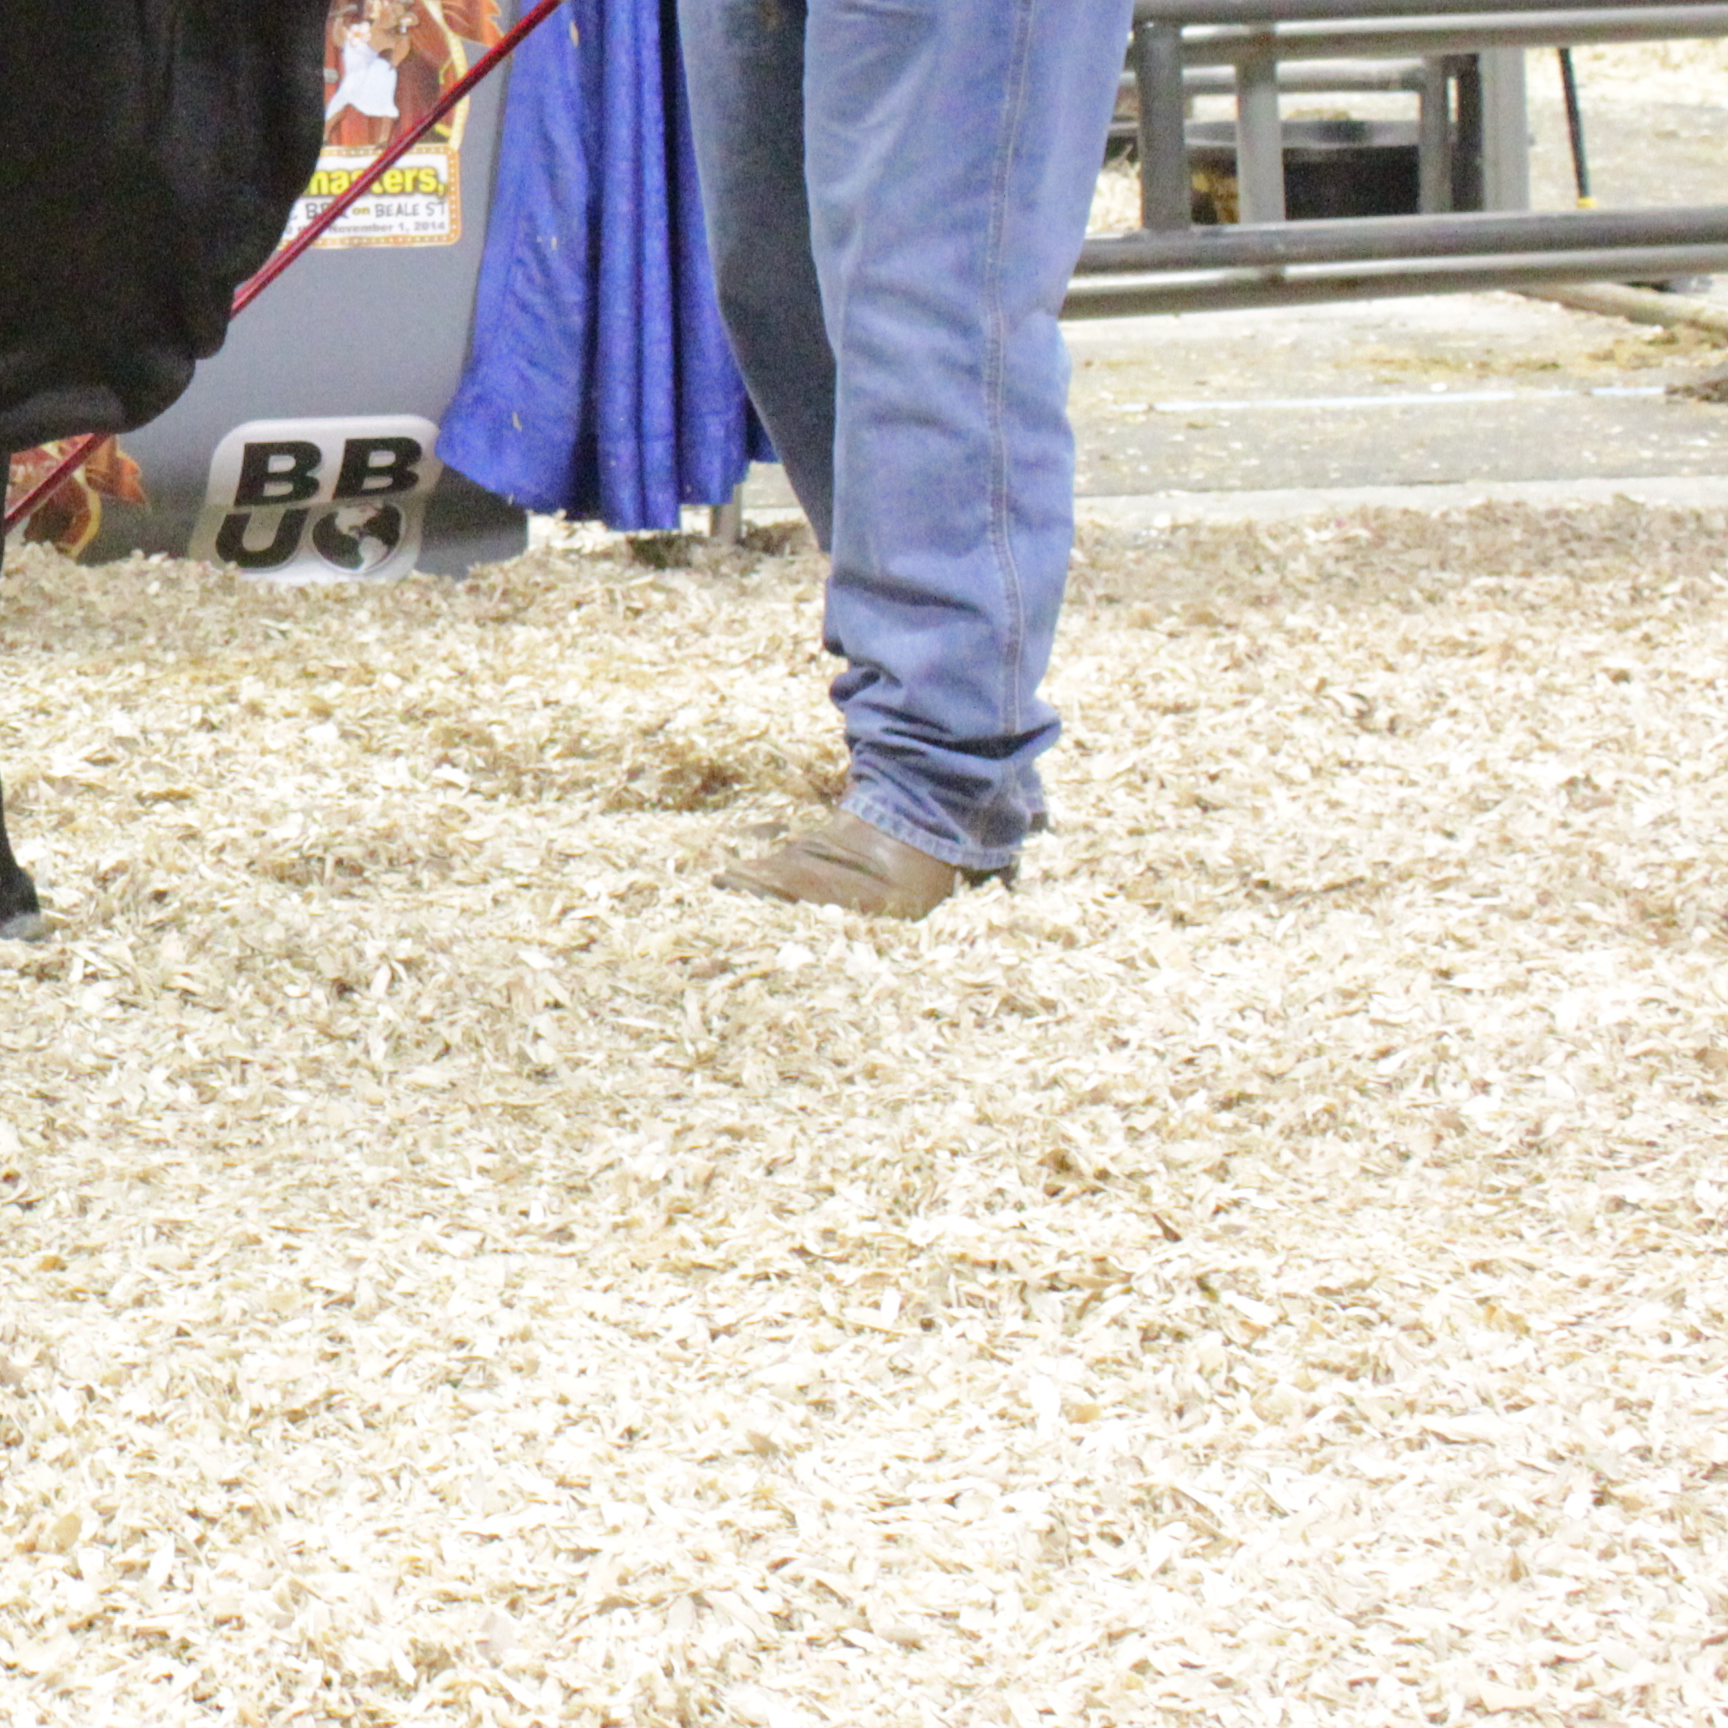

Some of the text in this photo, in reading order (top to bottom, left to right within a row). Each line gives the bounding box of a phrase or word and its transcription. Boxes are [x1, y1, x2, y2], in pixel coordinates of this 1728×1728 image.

[352, 206, 370, 215] on
[375, 203, 420, 218] BEALE
[425, 201, 445, 216] ST
[234, 437, 422, 507] BB
